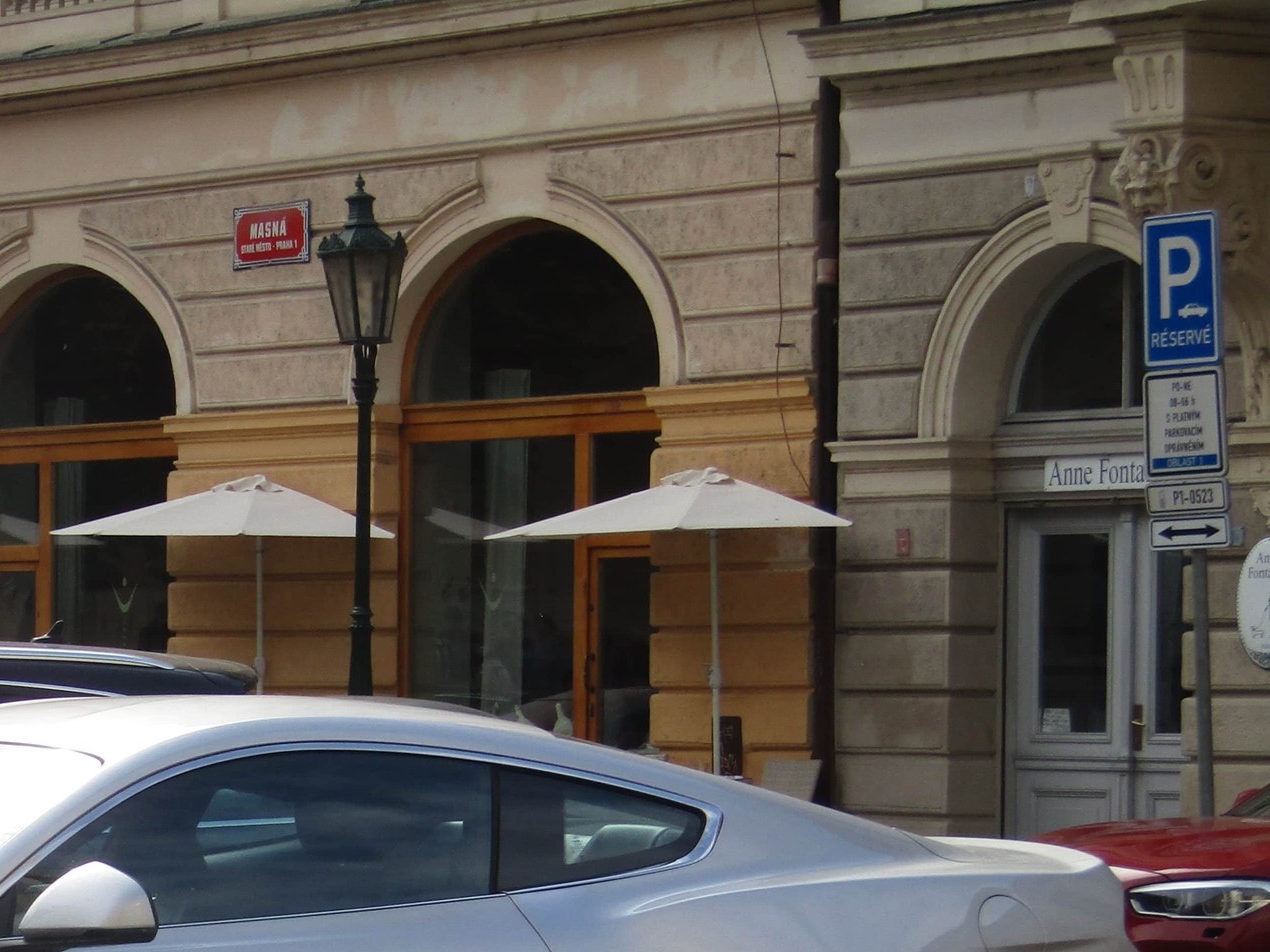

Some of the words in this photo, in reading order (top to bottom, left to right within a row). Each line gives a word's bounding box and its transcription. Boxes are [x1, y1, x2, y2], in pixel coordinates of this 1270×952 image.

[249, 216, 287, 239] MASNÁ
[275, 240, 293, 250] PRAHA
[294, 239, 298, 249] 1
[1159, 236, 1200, 320] P
[1151, 324, 1212, 348] RÉSERVÉ
[1166, 413, 1170, 423] S
[1172, 410, 1201, 422] PLATNÝM
[1165, 424, 1203, 438] PARKOVACÍM
[1164, 439, 1205, 454] OPRÁVNĚNÍM
[1166, 457, 1196, 468] OBLAST
[1048, 461, 1092, 487] Anne
[1172, 488, 1214, 505] P1-0523
